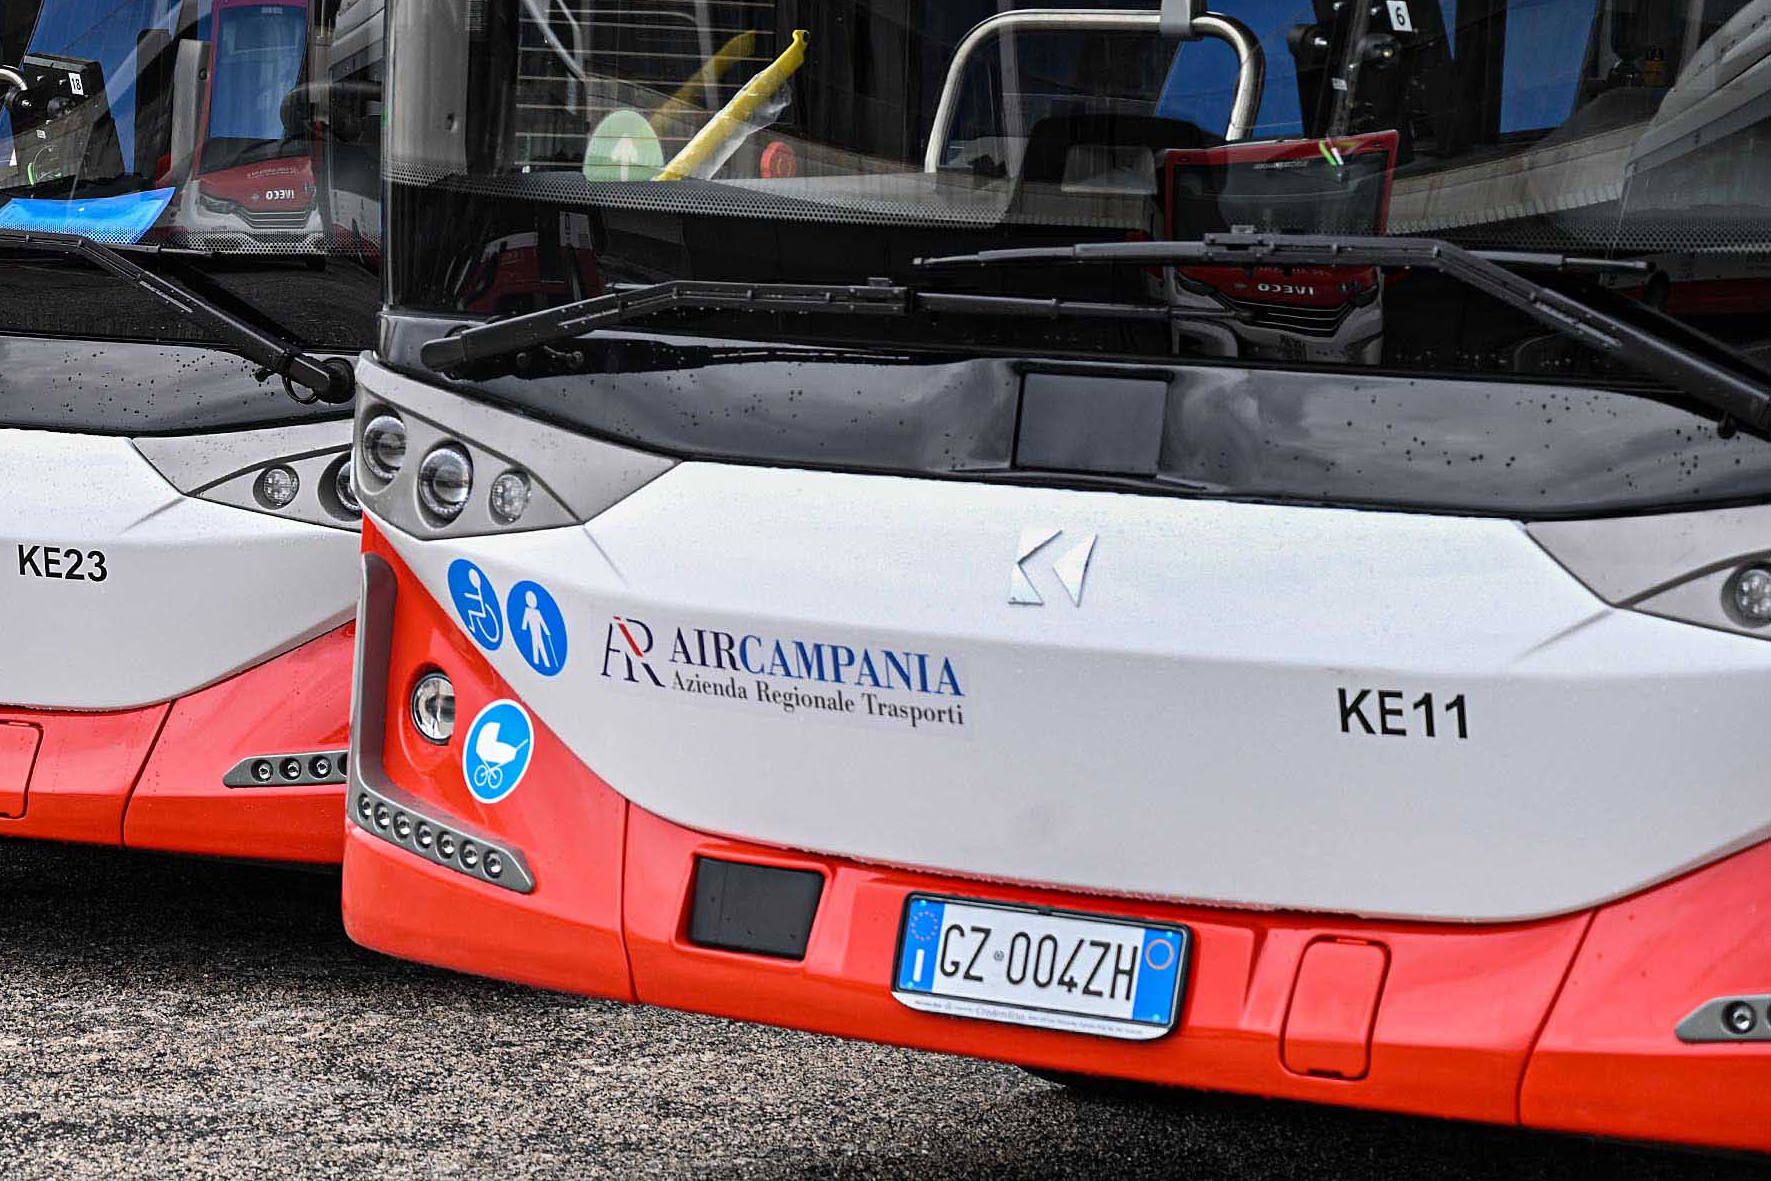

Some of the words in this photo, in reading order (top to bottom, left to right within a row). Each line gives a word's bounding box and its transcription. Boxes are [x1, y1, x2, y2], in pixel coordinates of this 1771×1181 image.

[1396, 7, 1405, 25] 6
[72, 77, 81, 90] 18
[18, 544, 107, 582] KE23
[669, 626, 965, 696] AIRCAMPANIA
[673, 671, 748, 701] Azienda
[756, 680, 855, 712] Regionale
[861, 693, 965, 728] Trasporti
[1338, 687, 1468, 739] KE11
